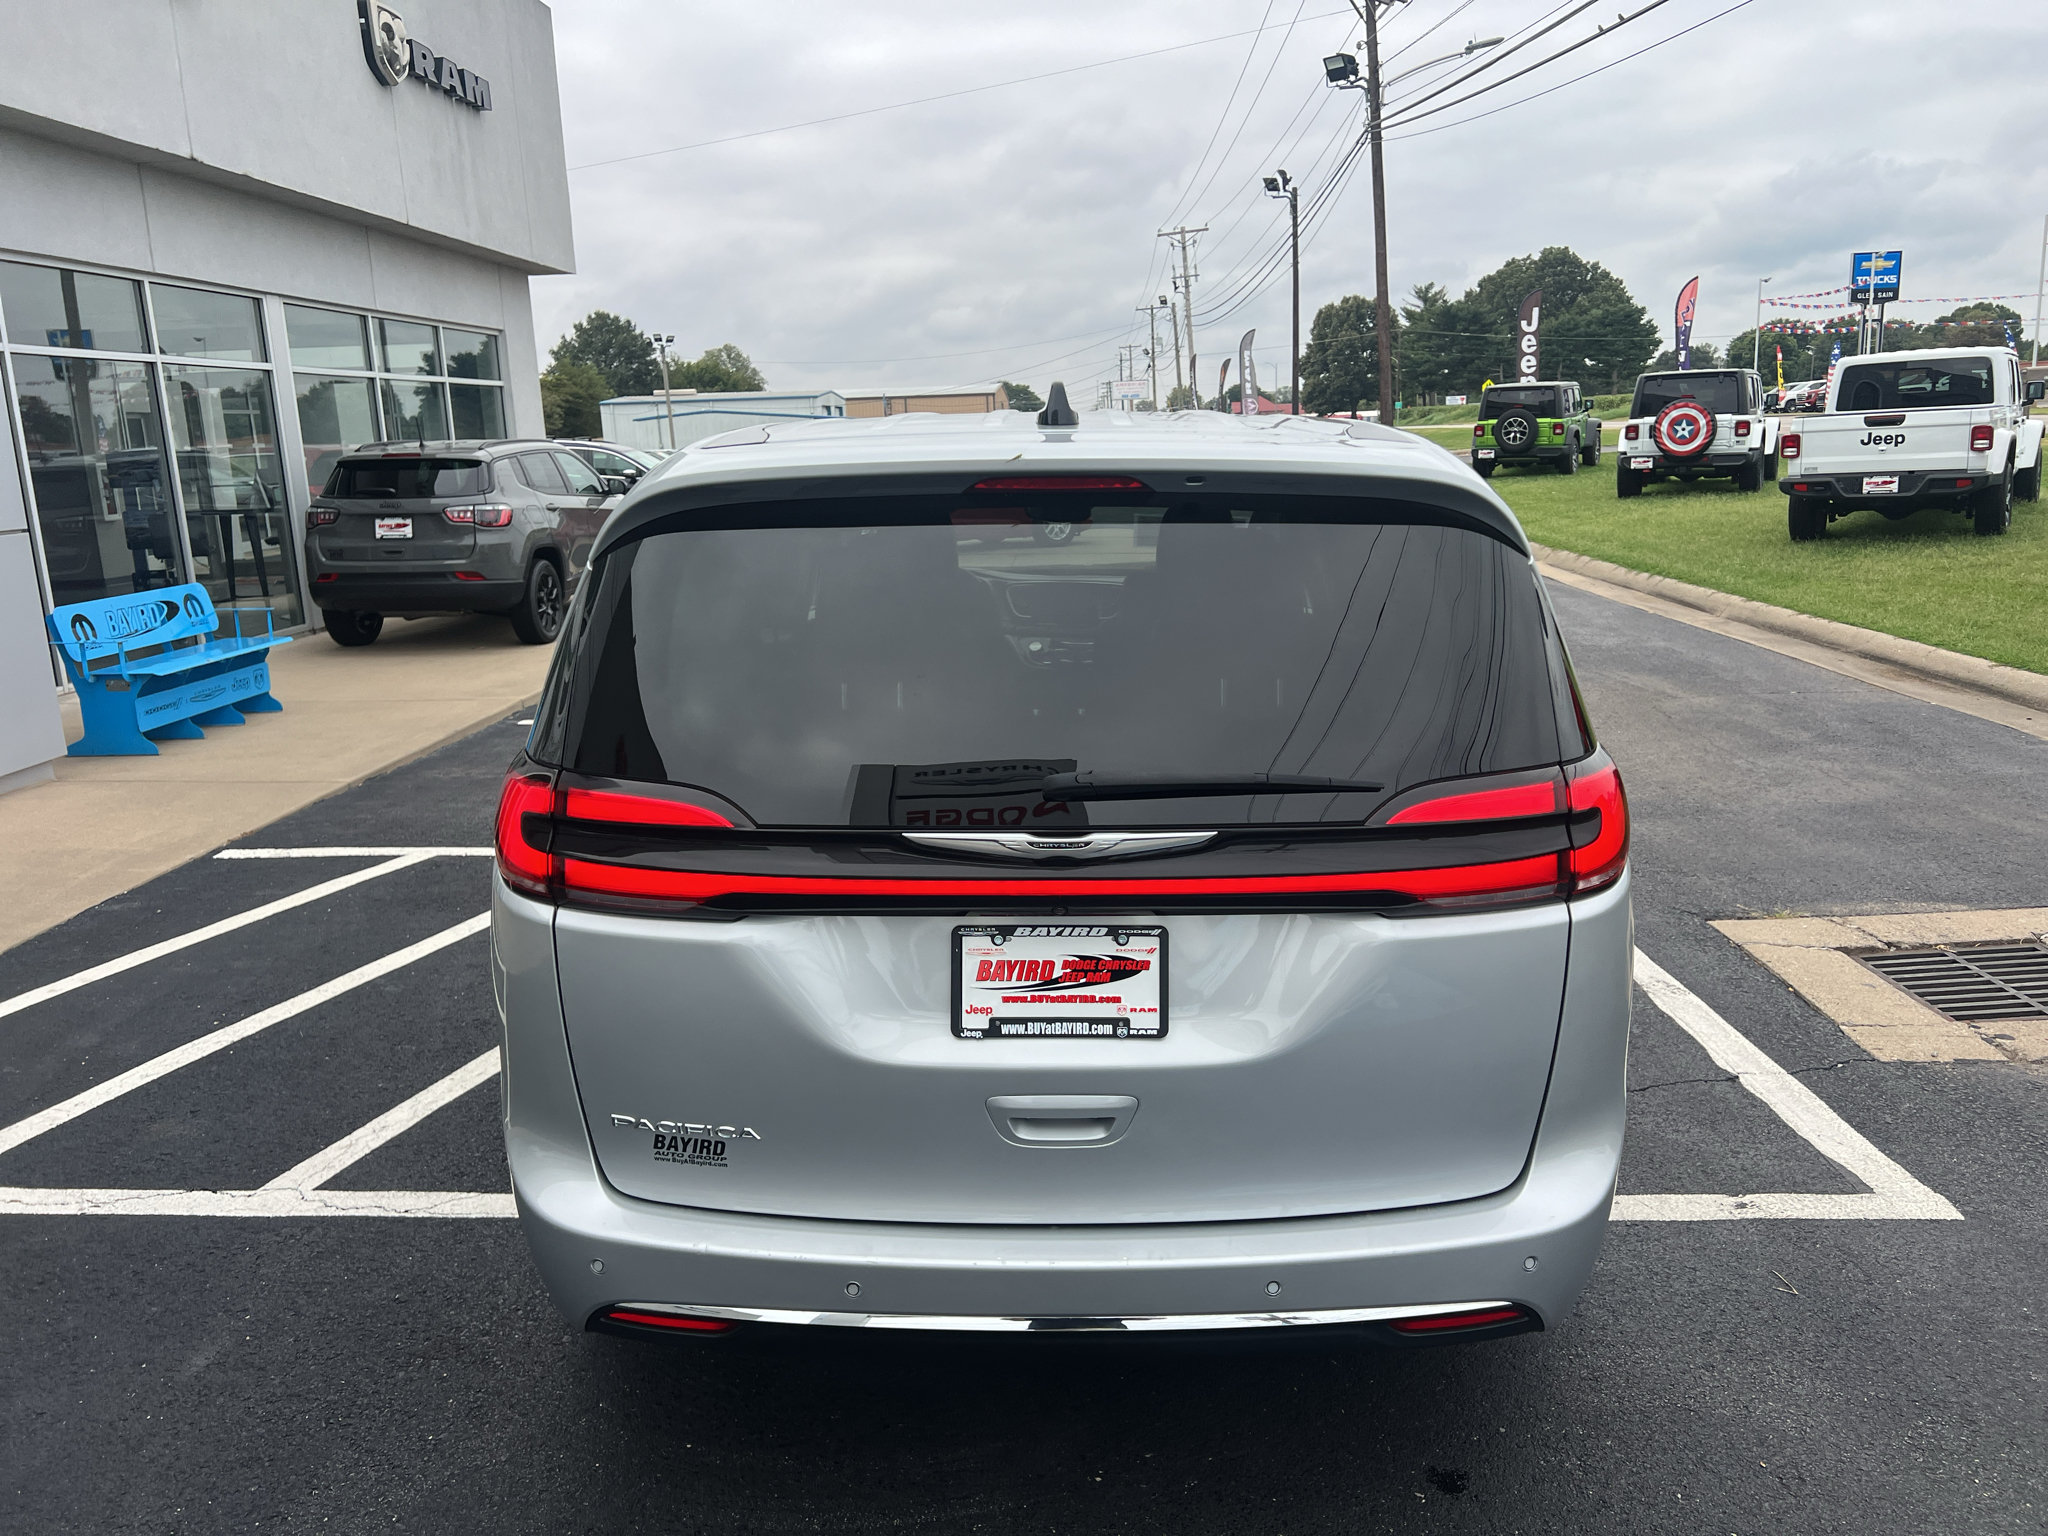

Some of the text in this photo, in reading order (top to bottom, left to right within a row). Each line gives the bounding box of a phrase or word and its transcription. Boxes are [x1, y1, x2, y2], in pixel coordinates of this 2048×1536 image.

[406, 39, 492, 111] RAM
[1244, 350, 1252, 395] RAM
[1860, 432, 1906, 447] Jeep
[104, 602, 161, 638] BAYIRD
[1013, 926, 1109, 938] BAYIRD
[975, 959, 1056, 982] BAYIRD
[1061, 960, 1151, 971] DODGE CHRYSLER
[1058, 972, 1112, 983] JEEP RAM
[1001, 994, 1122, 1004] www.BUYatBAYIRD.com
[965, 1004, 993, 1016] Jeep
[960, 1029, 983, 1038] Jeep
[1001, 1022, 1113, 1035] www.BUYatBAYIRD.com
[610, 1113, 762, 1140] PACIFICA
[653, 1134, 726, 1157] BAYIRD
[654, 1150, 728, 1162] AUTO GROUP
